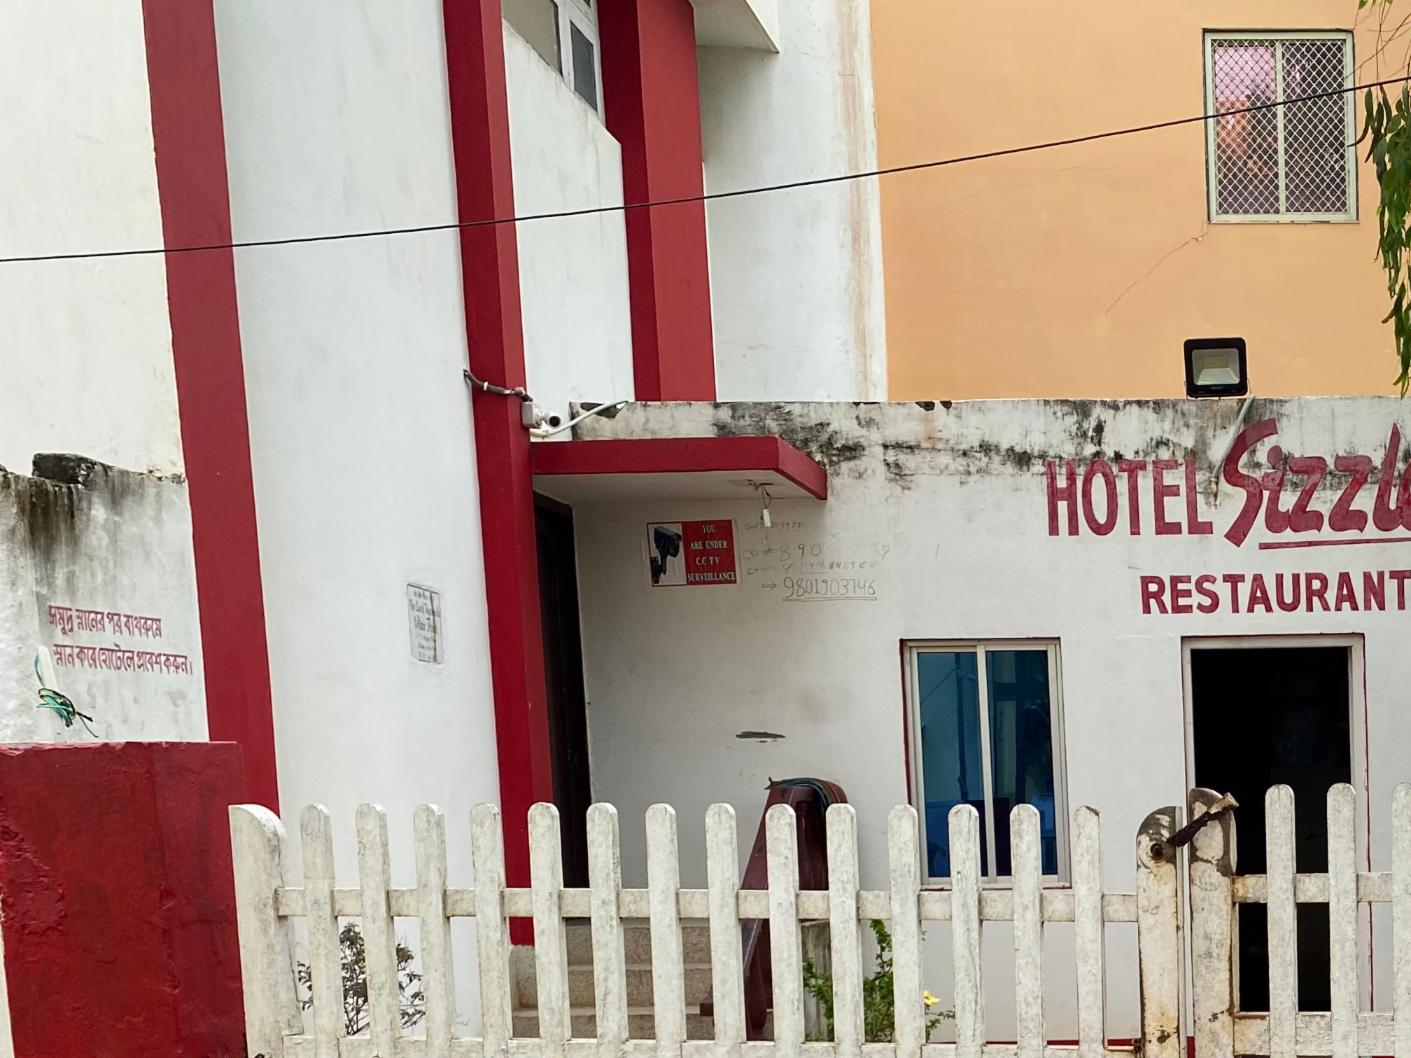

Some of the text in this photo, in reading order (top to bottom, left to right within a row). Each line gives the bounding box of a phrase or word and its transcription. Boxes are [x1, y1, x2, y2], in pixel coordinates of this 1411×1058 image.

[1046, 458, 1213, 536] HOTEL
[690, 539, 728, 550] ARE UNDER
[687, 571, 737, 582] SURVEILLANCE
